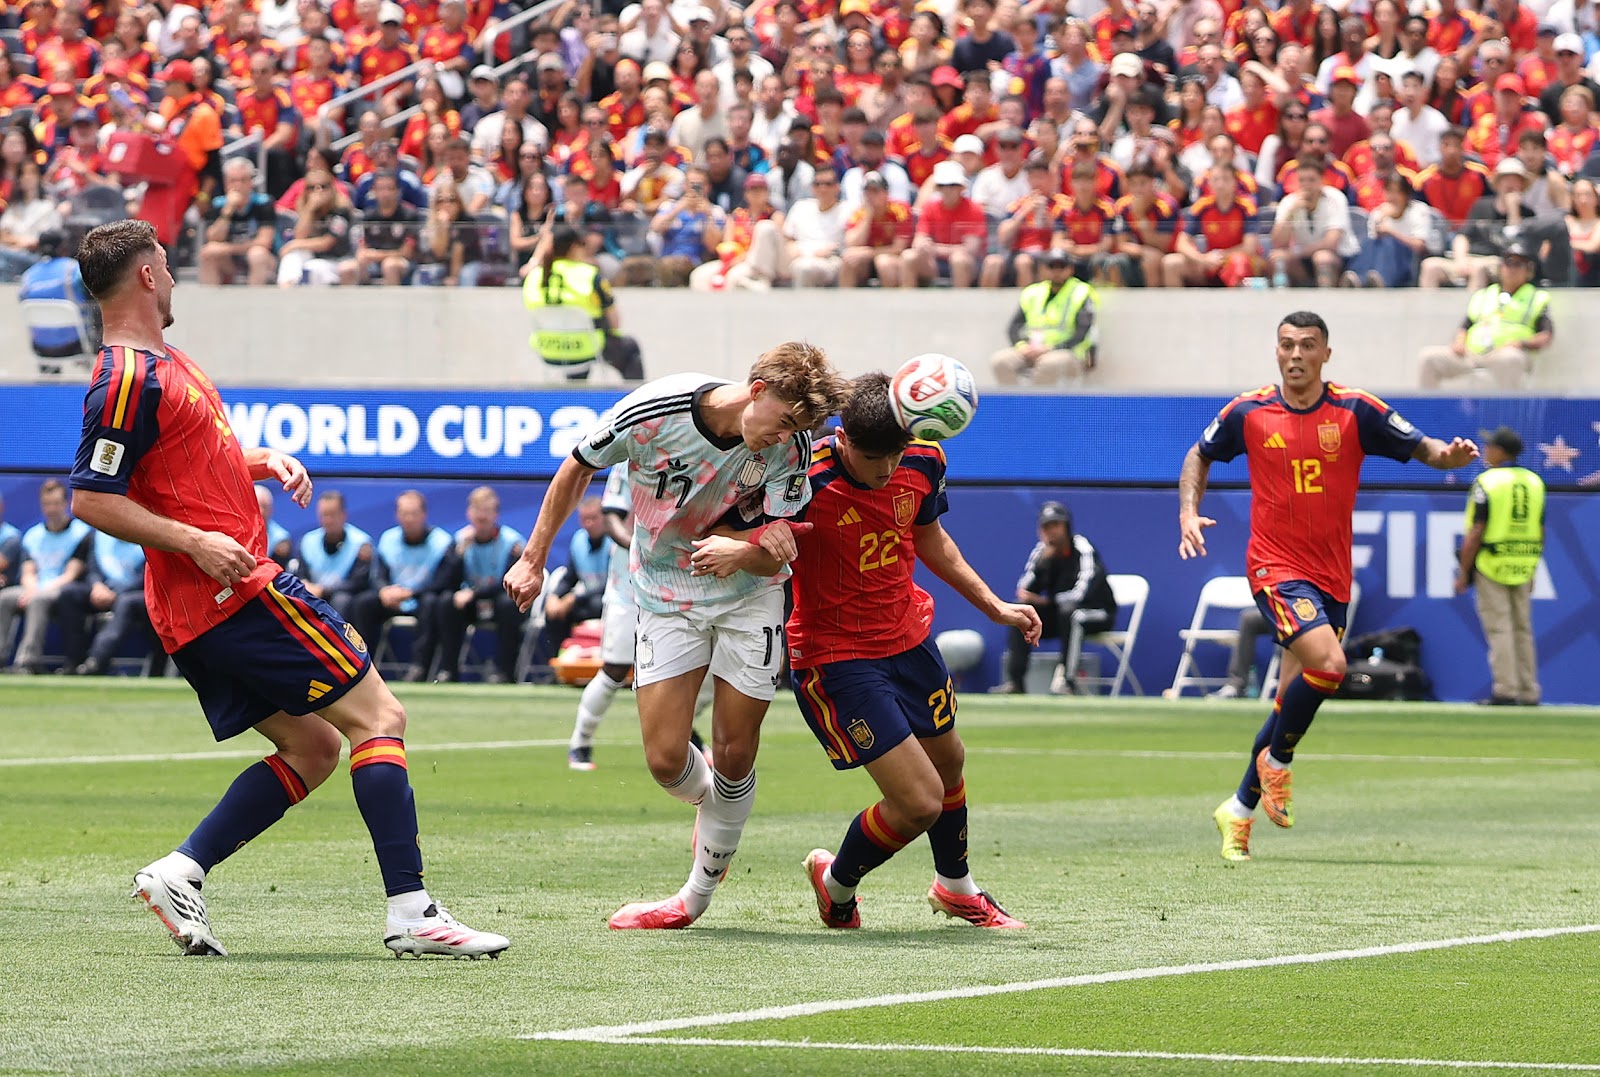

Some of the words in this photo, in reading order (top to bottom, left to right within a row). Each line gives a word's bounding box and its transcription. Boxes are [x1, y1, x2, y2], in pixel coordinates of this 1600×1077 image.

[222, 402, 420, 455] WORLD
[426, 405, 543, 458] CUP
[655, 471, 693, 509] 17
[1291, 459, 1324, 494] 12
[859, 529, 901, 574] 22
